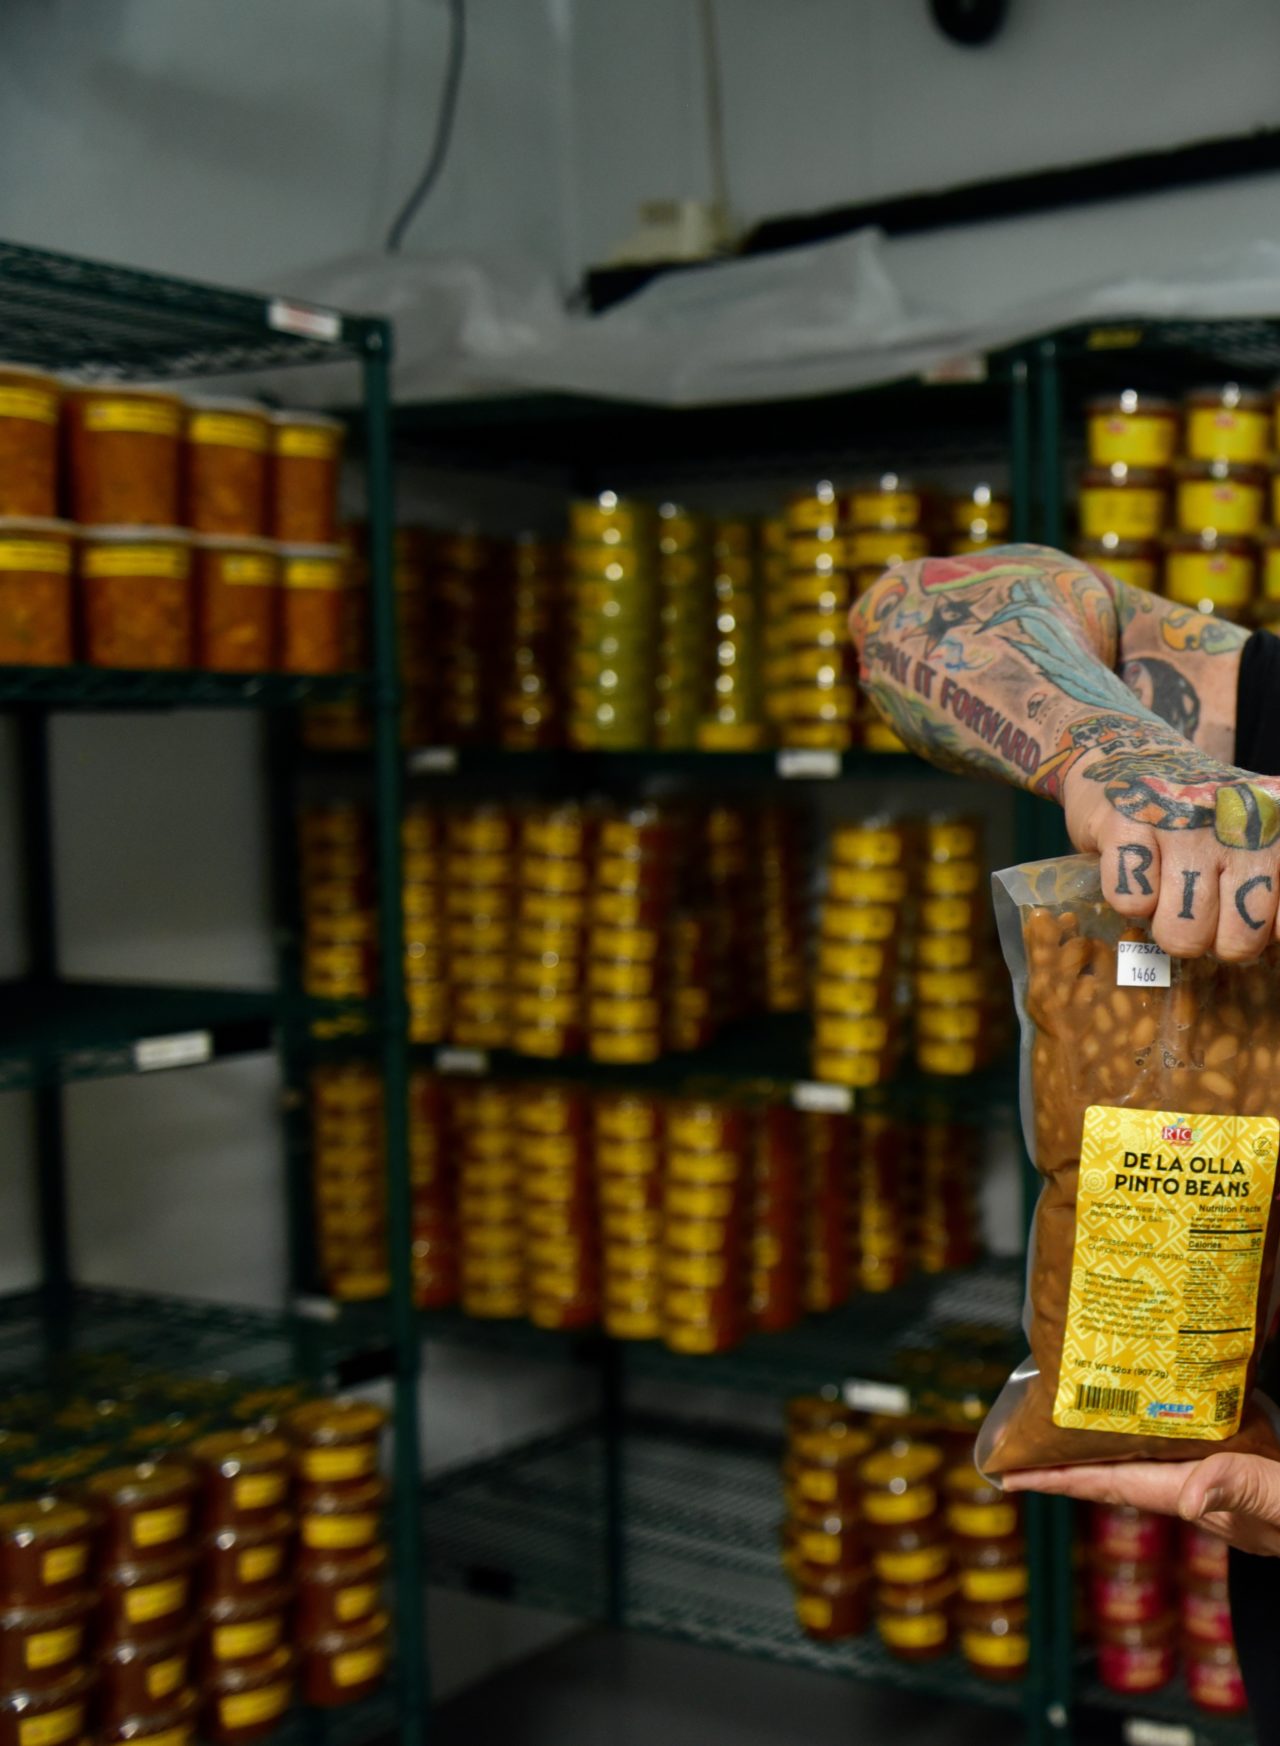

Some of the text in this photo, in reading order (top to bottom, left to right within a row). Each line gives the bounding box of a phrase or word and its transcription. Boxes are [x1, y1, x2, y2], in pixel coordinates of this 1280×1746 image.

[914, 661, 937, 699] IT
[940, 677, 1041, 776] FORWARD
[1120, 943, 1168, 955] 07/25/2
[1132, 967, 1156, 982] 1466
[1123, 1151, 1246, 1175] DE LA OLLA
[1114, 1174, 1250, 1198] PINTO BEANS
[1199, 1204, 1261, 1213] Nutrition Facts
[1188, 1240, 1221, 1249] Calories
[1074, 1359, 1091, 1369] NET
[1095, 1362, 1107, 1372] WT
